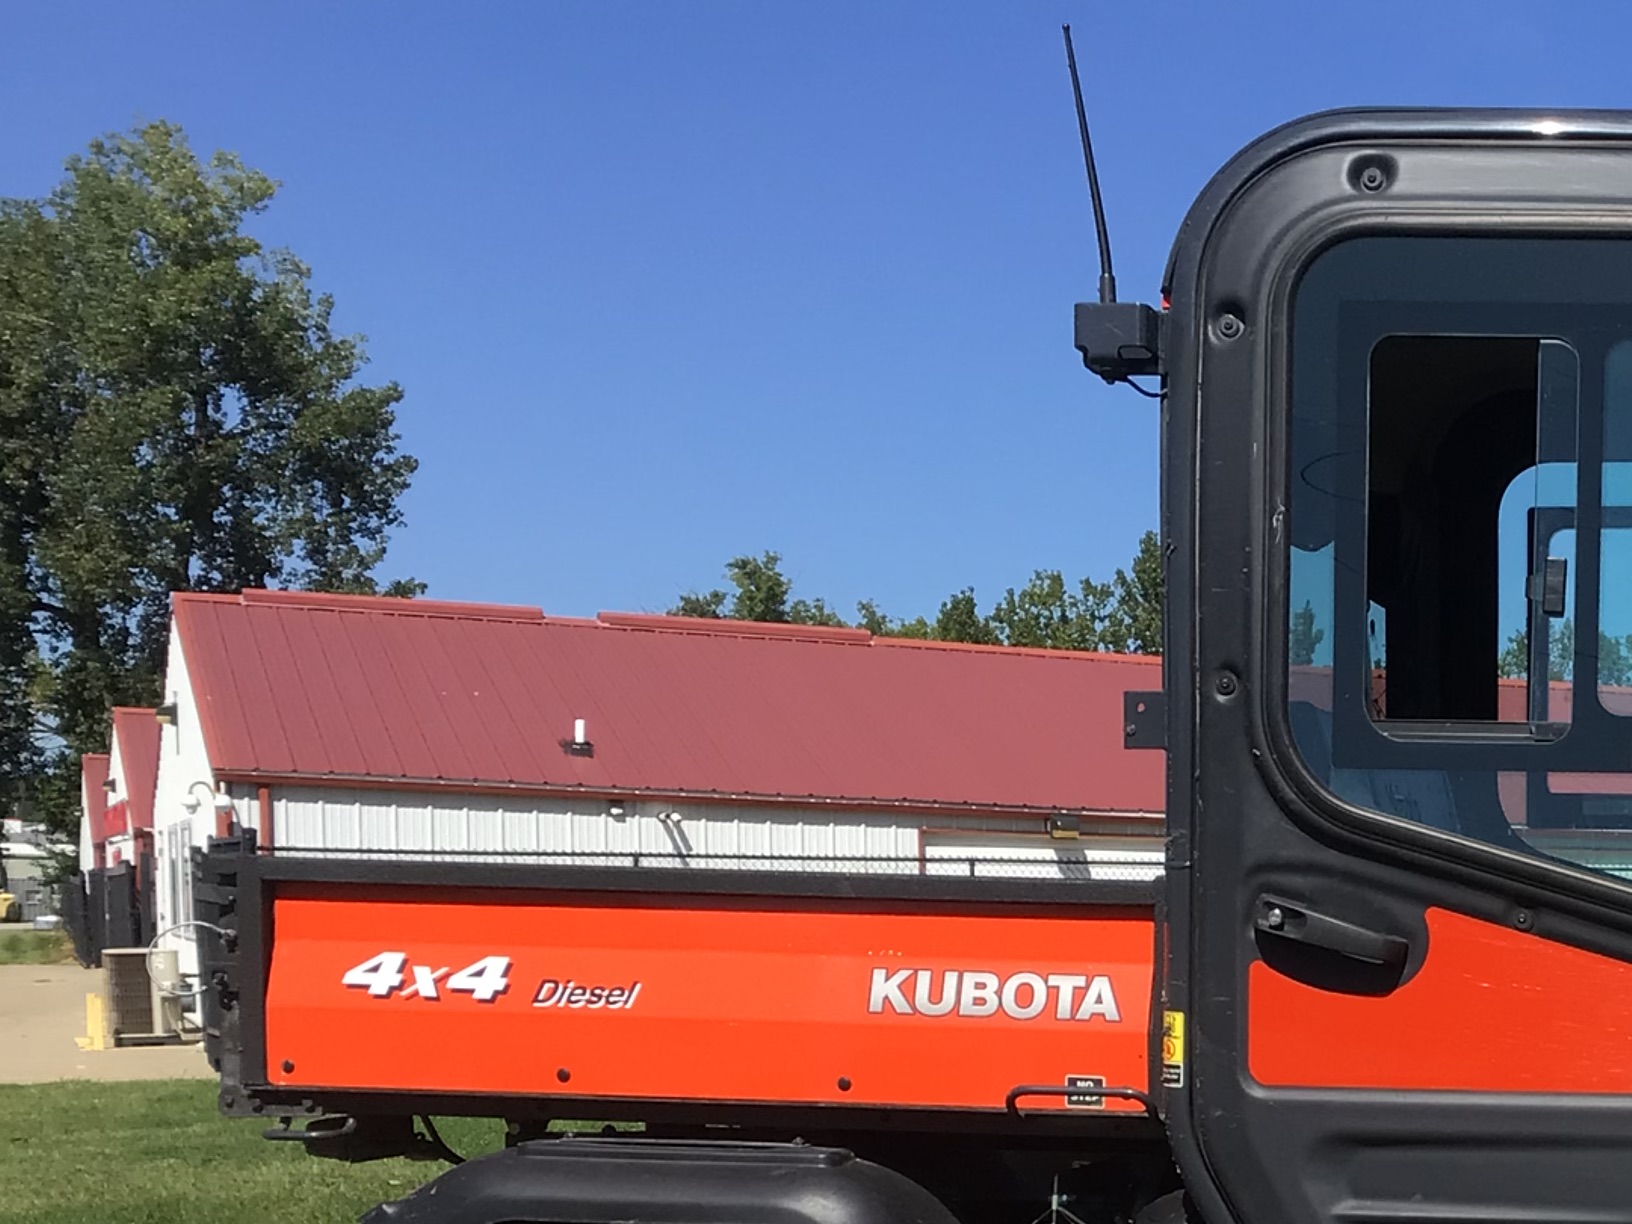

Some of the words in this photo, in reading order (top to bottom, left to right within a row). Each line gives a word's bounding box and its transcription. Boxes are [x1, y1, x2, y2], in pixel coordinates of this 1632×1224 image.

[341, 951, 513, 1004] 4x4
[533, 979, 641, 1009] Diesel
[867, 967, 1122, 1023] KUBOTA
